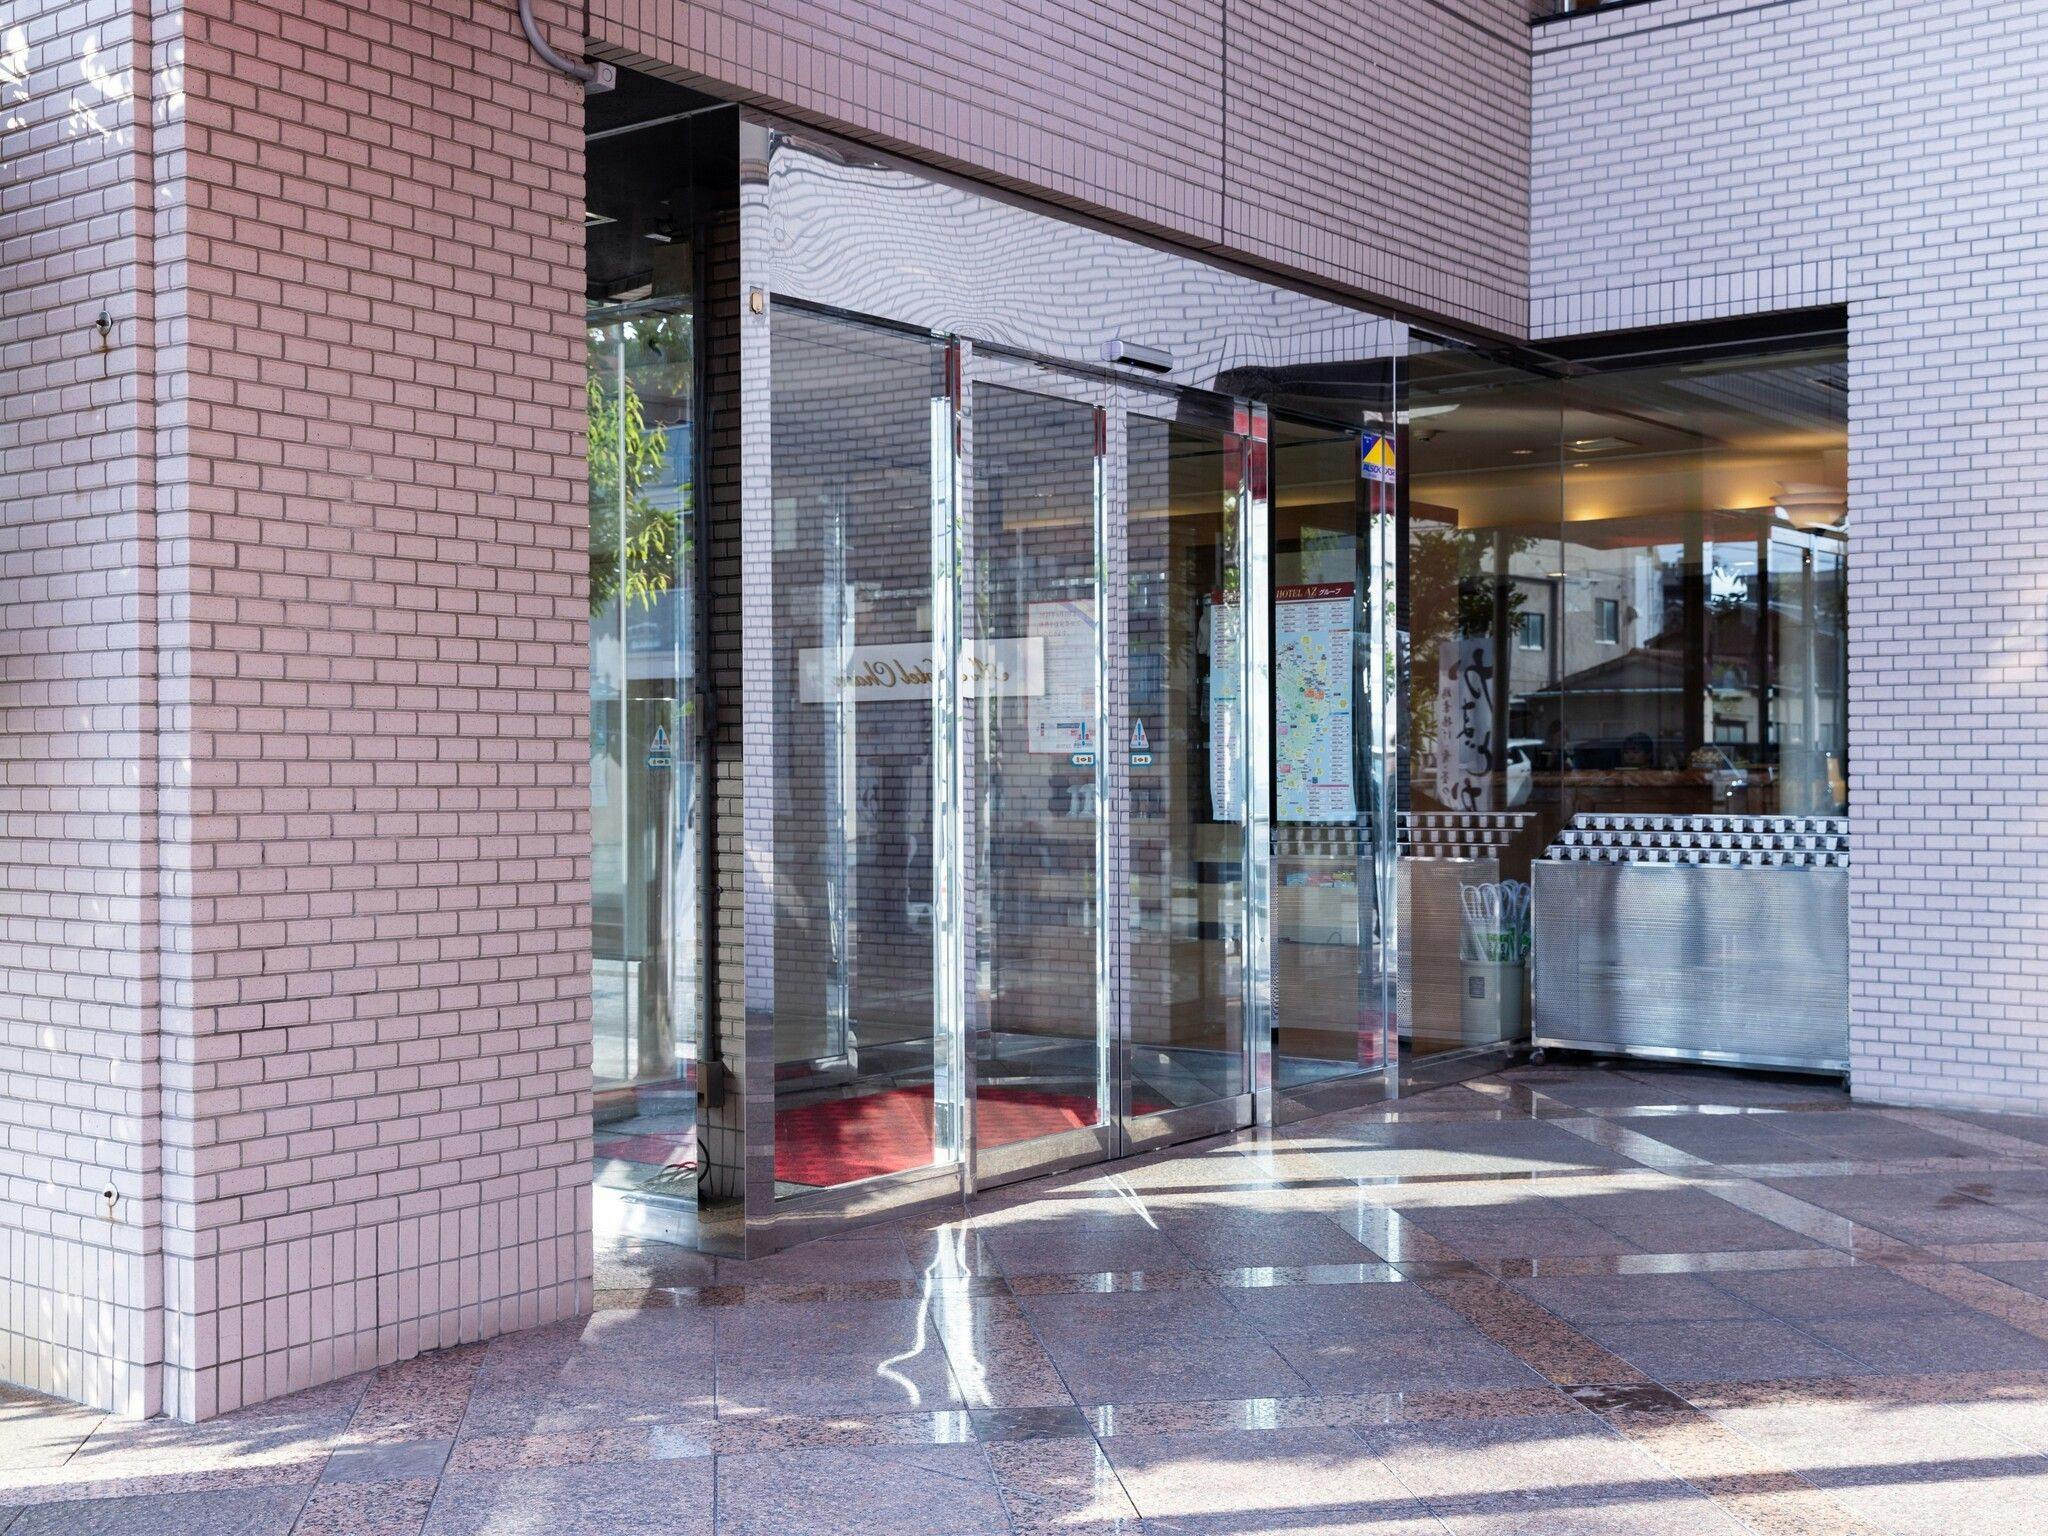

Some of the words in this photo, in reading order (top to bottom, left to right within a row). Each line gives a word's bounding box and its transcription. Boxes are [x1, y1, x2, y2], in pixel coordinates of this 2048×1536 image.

[1276, 589, 1302, 599] HOTEL
[1304, 587, 1318, 598] AZ
[1319, 587, 1342, 597] グループ
